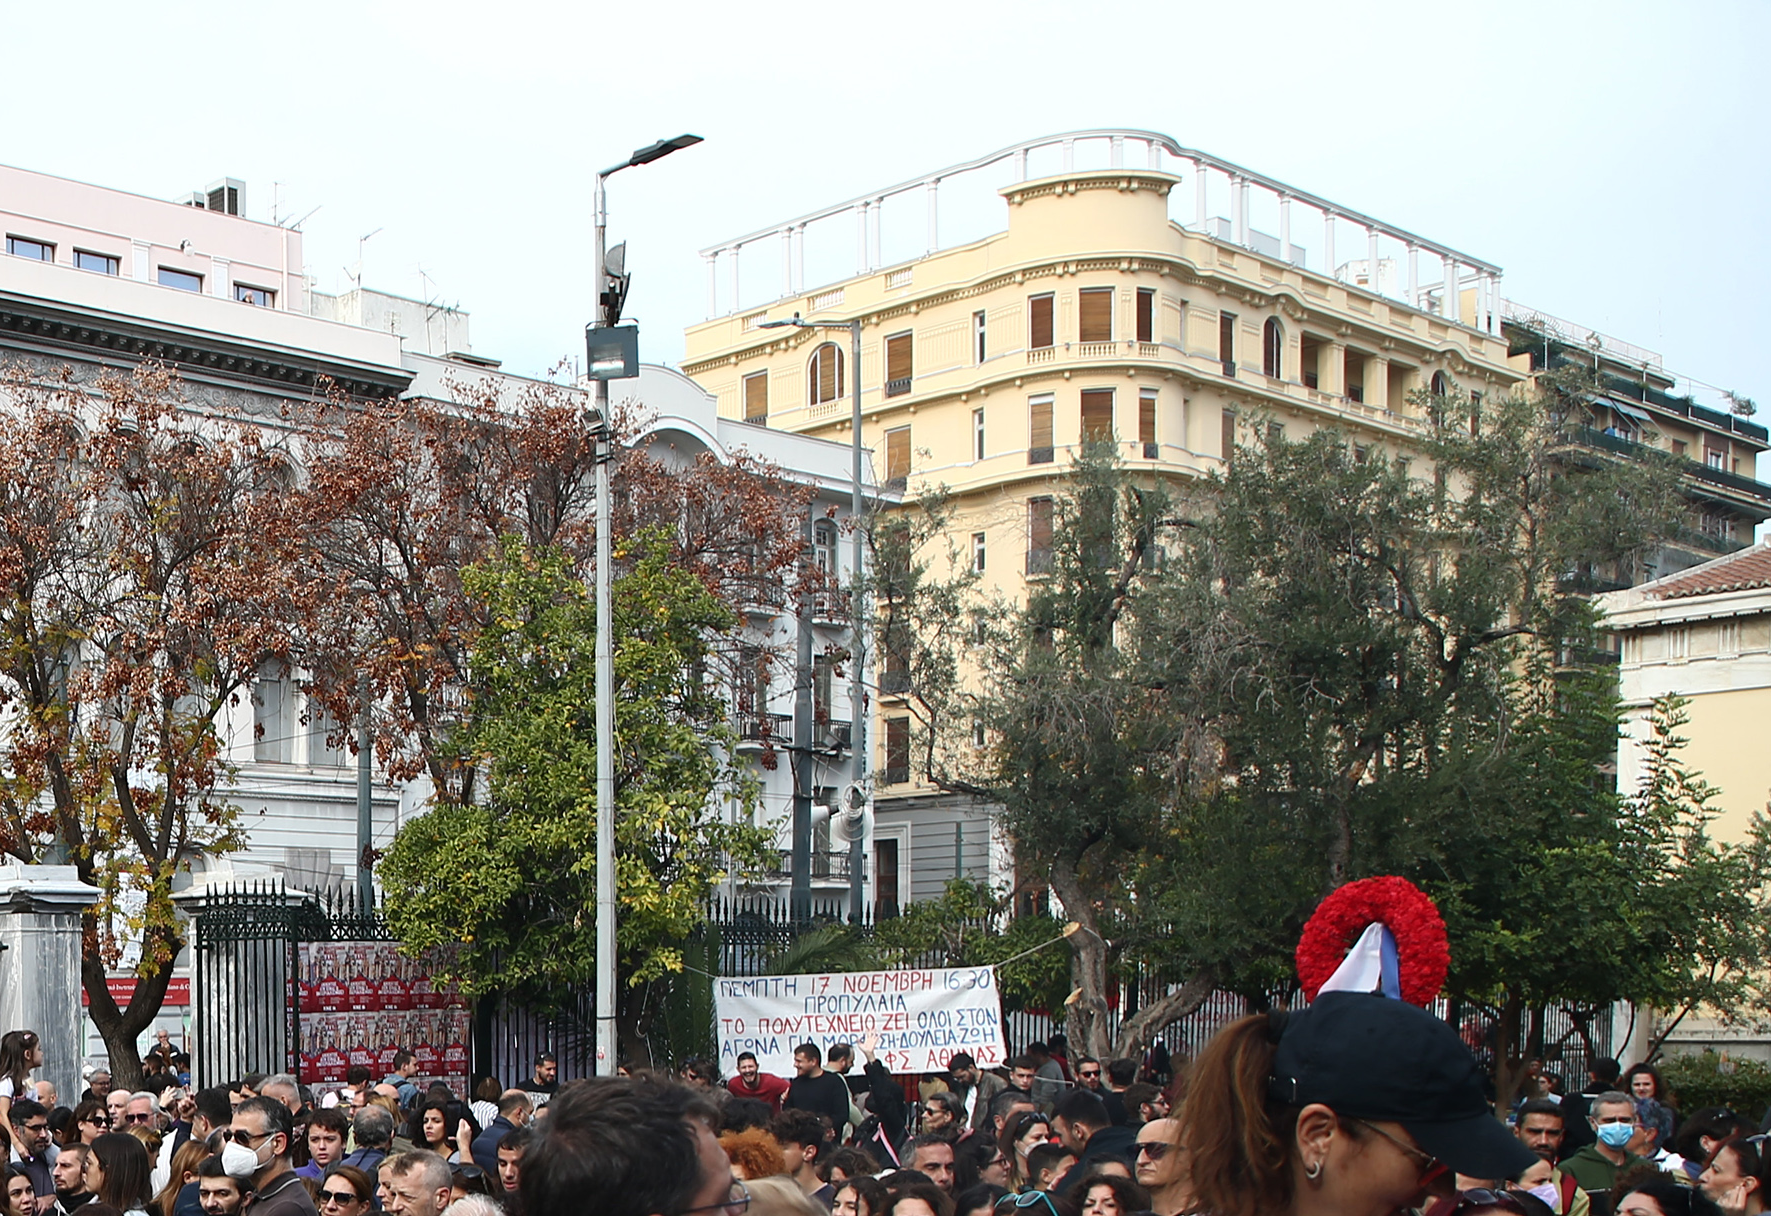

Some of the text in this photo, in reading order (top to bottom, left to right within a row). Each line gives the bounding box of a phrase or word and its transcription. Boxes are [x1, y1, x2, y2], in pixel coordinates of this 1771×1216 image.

[720, 977, 797, 998] ΠΕΜΠΤΗ
[811, 976, 830, 995] 17
[844, 971, 933, 993] ΝΟΕΜΒΡΗ
[804, 994, 907, 1014] ΠΡΟΠΥΛΑΙΑ
[721, 1007, 998, 1034] ΤΟ ΠΟΛΥΤΕΧΝΕΙΟ ΖΕΙ ΟΛΟΙ ΣΤΟΝ
[721, 1036, 780, 1058] ΑΓΩΝΑ
